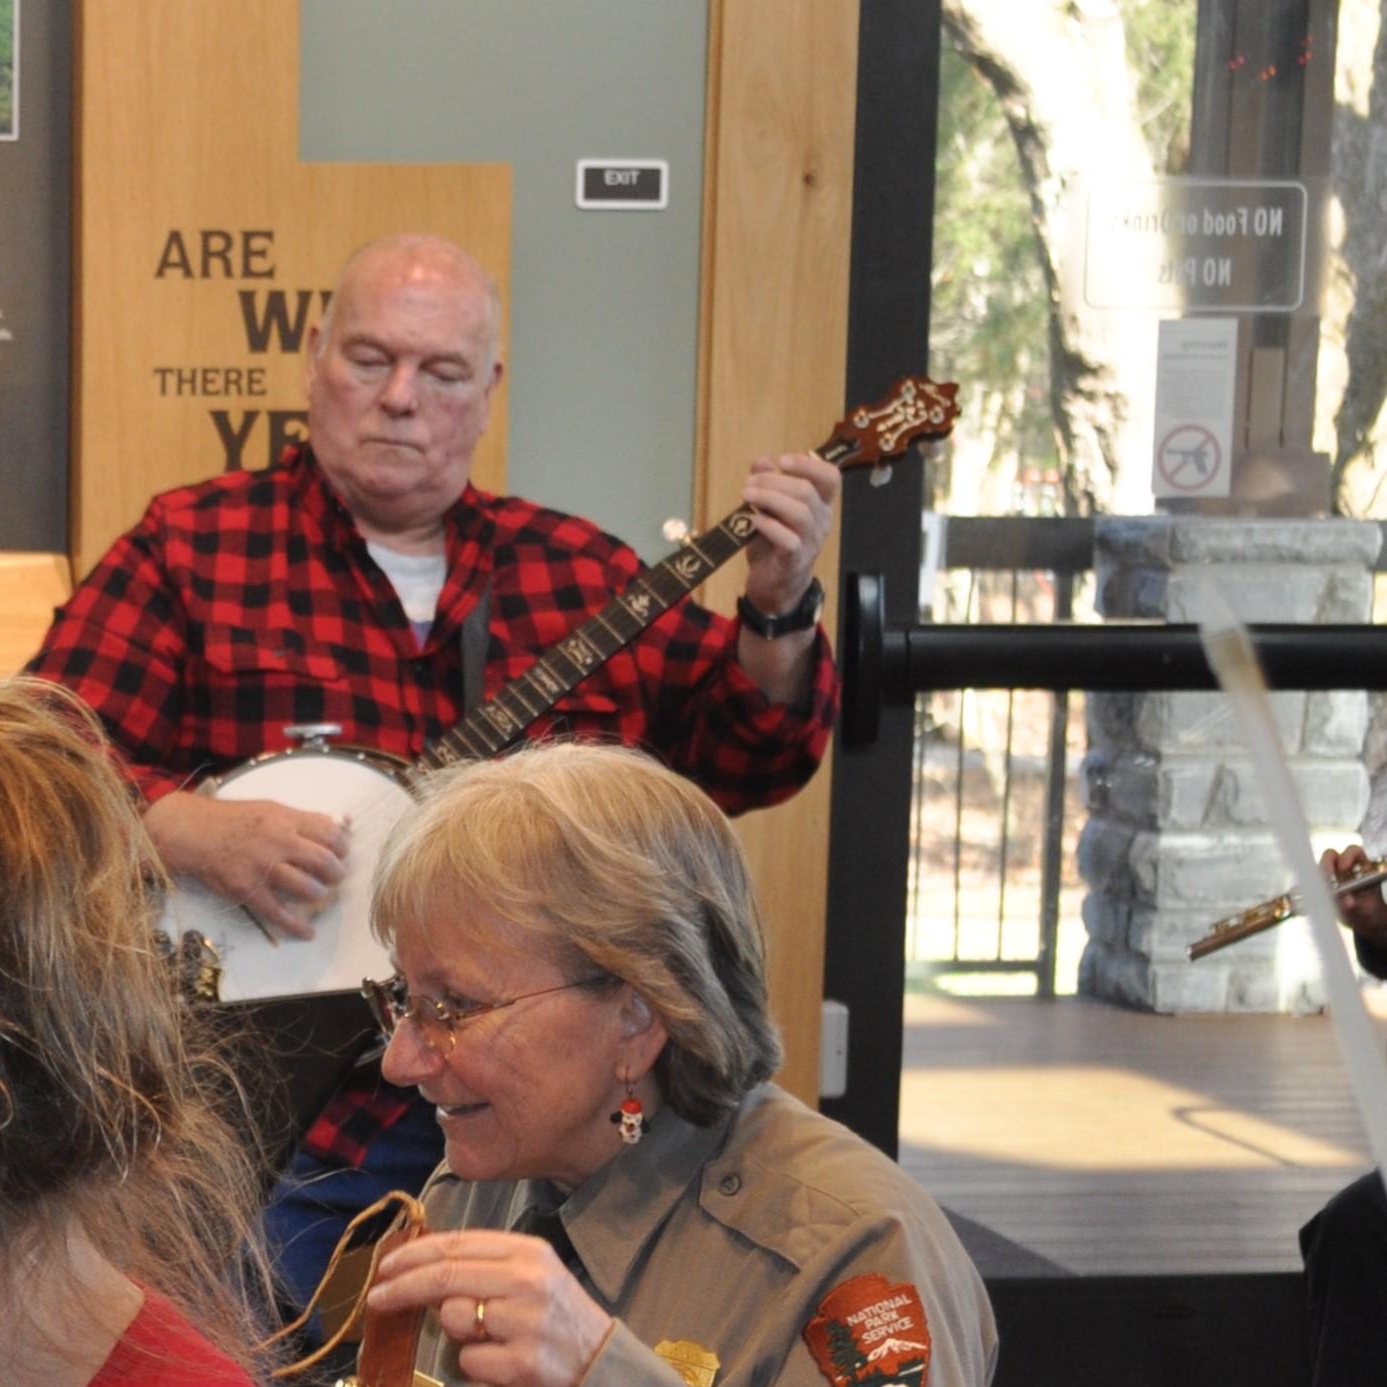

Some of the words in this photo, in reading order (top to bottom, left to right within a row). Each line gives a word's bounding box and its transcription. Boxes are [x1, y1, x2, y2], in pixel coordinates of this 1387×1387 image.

[604, 170, 640, 186] EXIT
[154, 229, 276, 280] ARE
[238, 290, 335, 354] W
[153, 368, 267, 396] THERE
[209, 410, 311, 473] YE
[846, 1294, 913, 1327] NATIONAL
[864, 1311, 900, 1330] PARK
[862, 1317, 914, 1344] SERVICE
